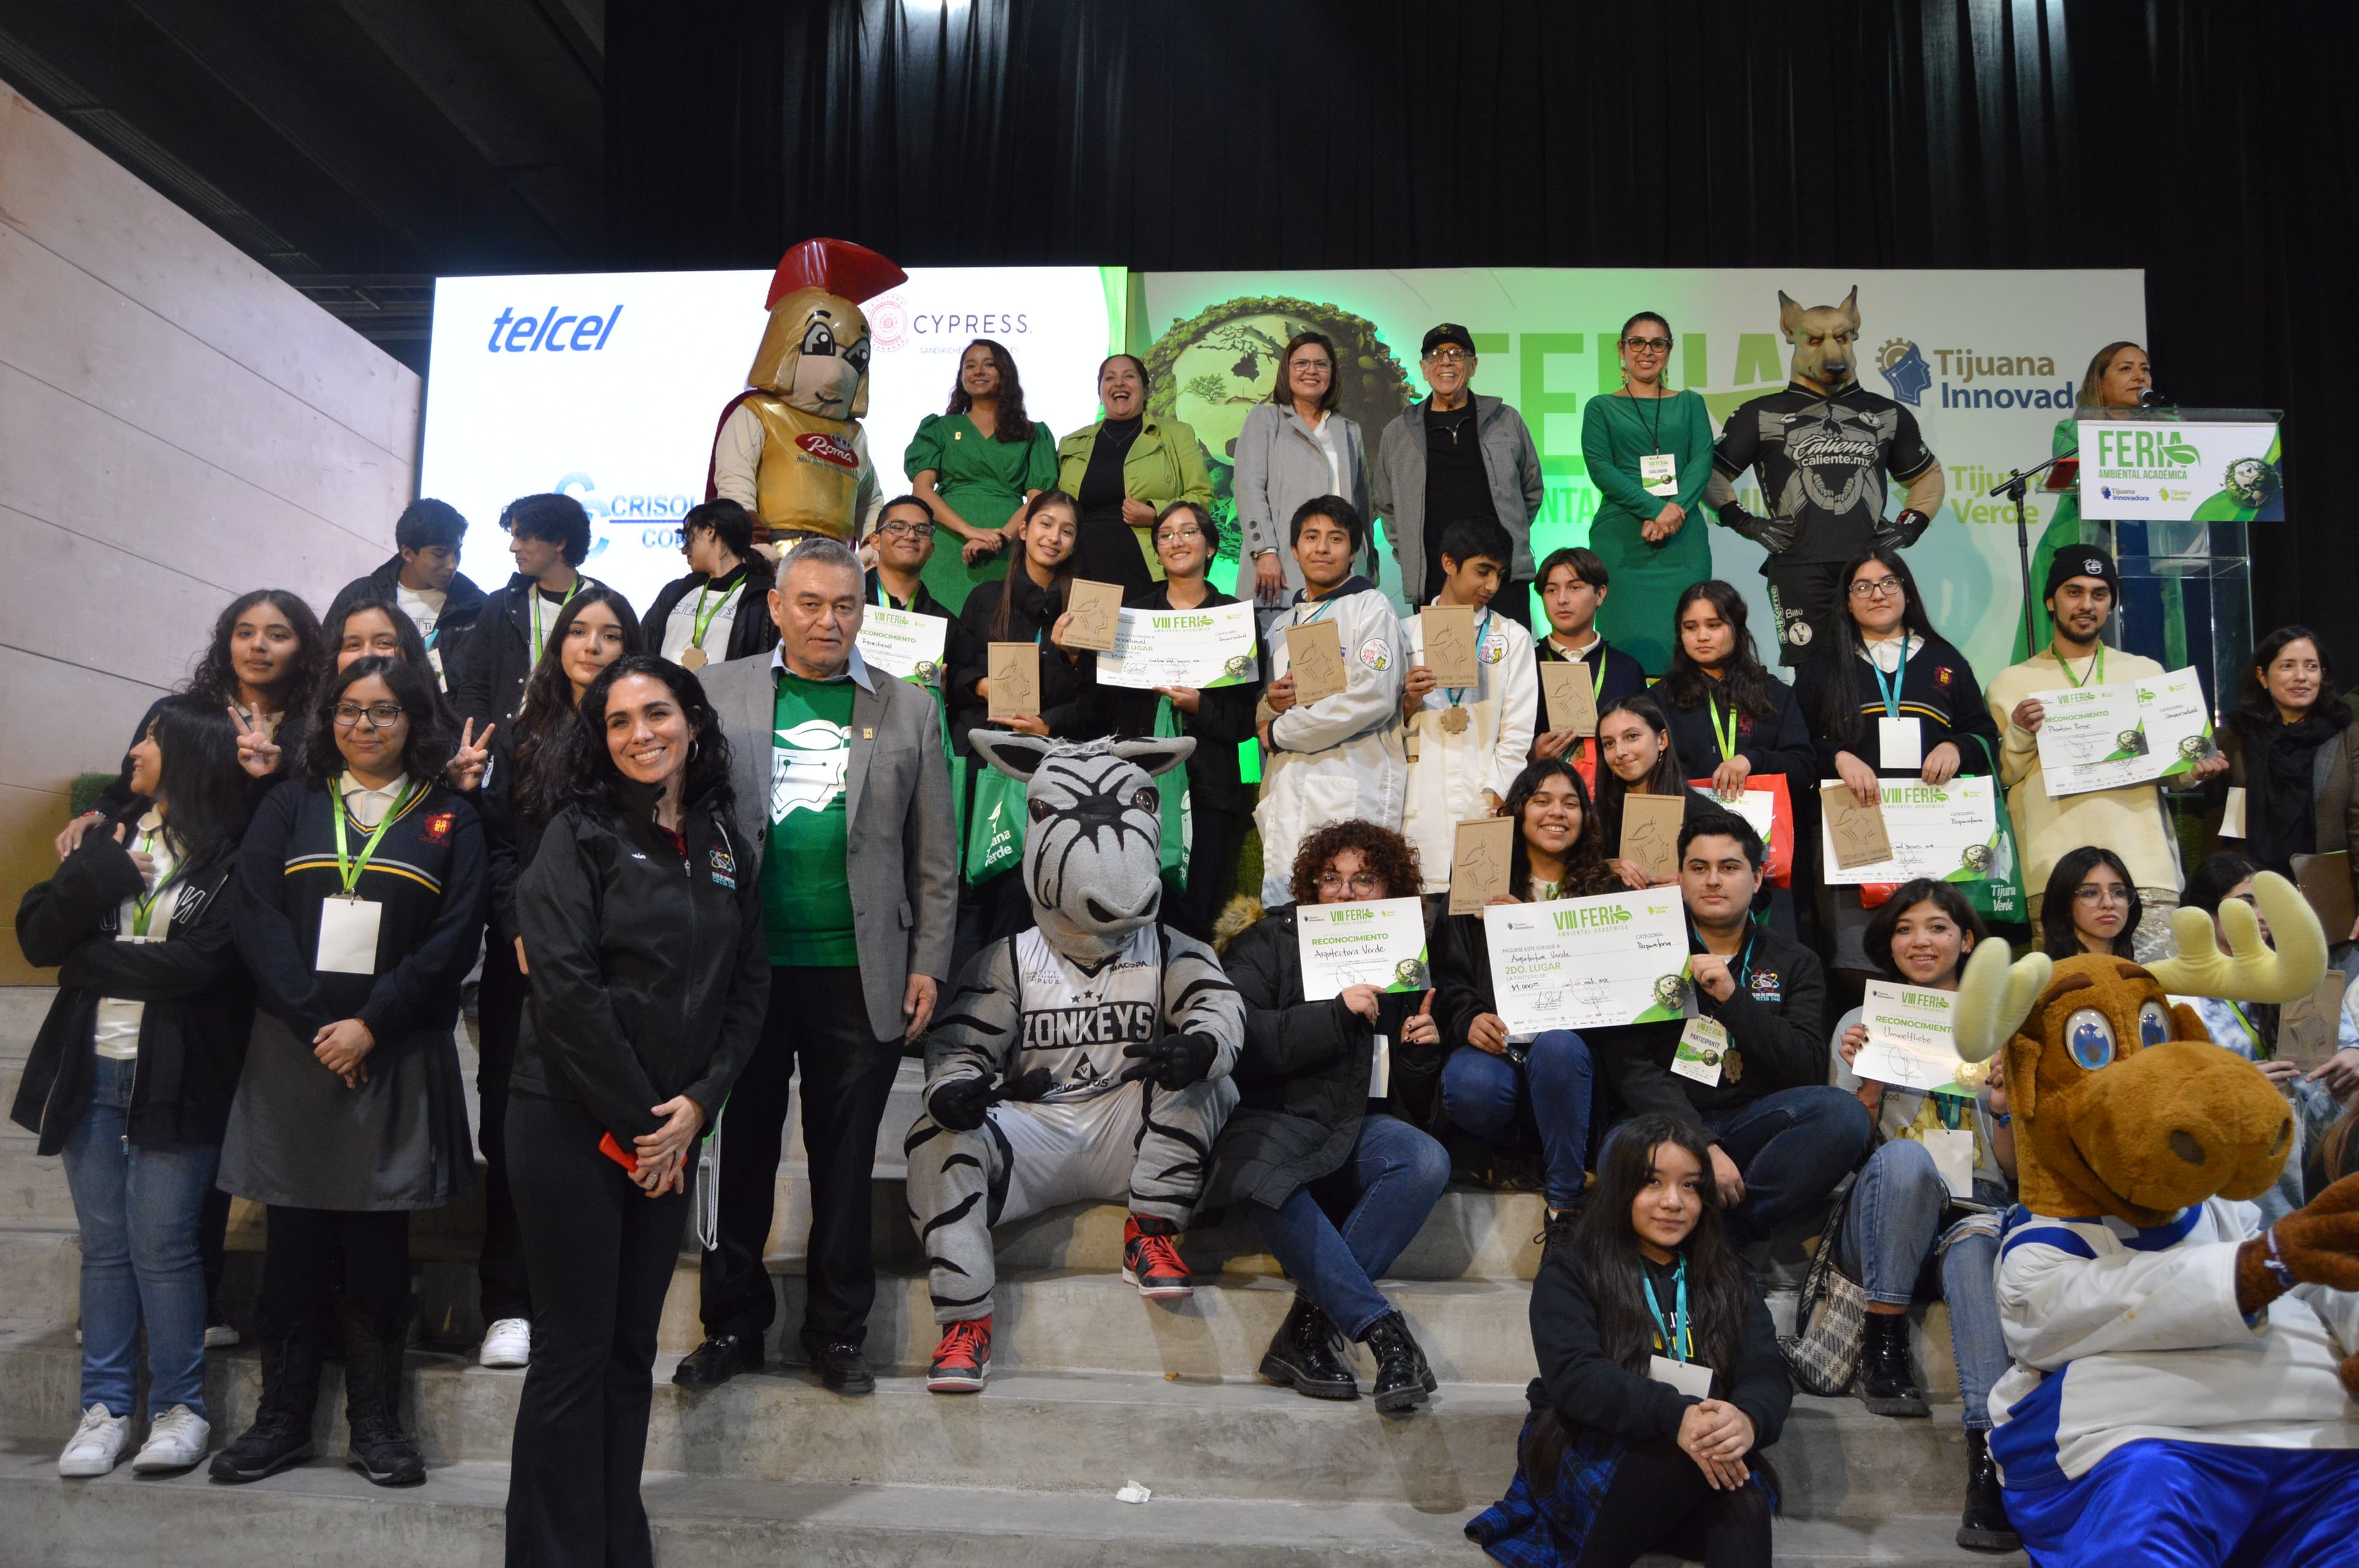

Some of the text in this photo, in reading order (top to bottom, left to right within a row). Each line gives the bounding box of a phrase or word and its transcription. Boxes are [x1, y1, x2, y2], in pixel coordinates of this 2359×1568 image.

[488, 305, 624, 353] telcel
[1934, 349, 2055, 383] Tijuana
[807, 435, 852, 462] Roma
[1792, 435, 1875, 460] Caliente
[2098, 430, 2194, 468] FERIA
[1801, 454, 1871, 467] caliente.mx
[1949, 466, 2044, 499] Tijun
[2099, 469, 2141, 479] AMBIENTAL
[1951, 498, 2039, 525] Verde
[886, 614, 909, 625] FERIA
[1152, 615, 1215, 628] VIII FERIA
[859, 629, 917, 644] ECONOCIMIENTO
[2070, 692, 2096, 704] FERIA
[2044, 711, 2109, 723] RECONOCIMIENTO
[1882, 788, 1902, 803] VIII
[1904, 787, 1950, 803] FERIA
[1993, 899, 2013, 911] Verde
[1331, 910, 1345, 922] VIII
[1345, 908, 1375, 921] FERIA
[1553, 904, 1633, 930] VIII FERIA
[1312, 933, 1388, 946] RECONOCIMIENTO
[1315, 943, 1386, 961] Arquitectura Verde
[1505, 962, 1562, 975] 2DO. LUGAR
[1901, 991, 1950, 1008] VIII FERIA
[1023, 1004, 1154, 1048] ZONKEYS
[1876, 1015, 1954, 1034] RECONOCIMIENT
[1689, 1032, 1721, 1049] PARTICIPANTE
